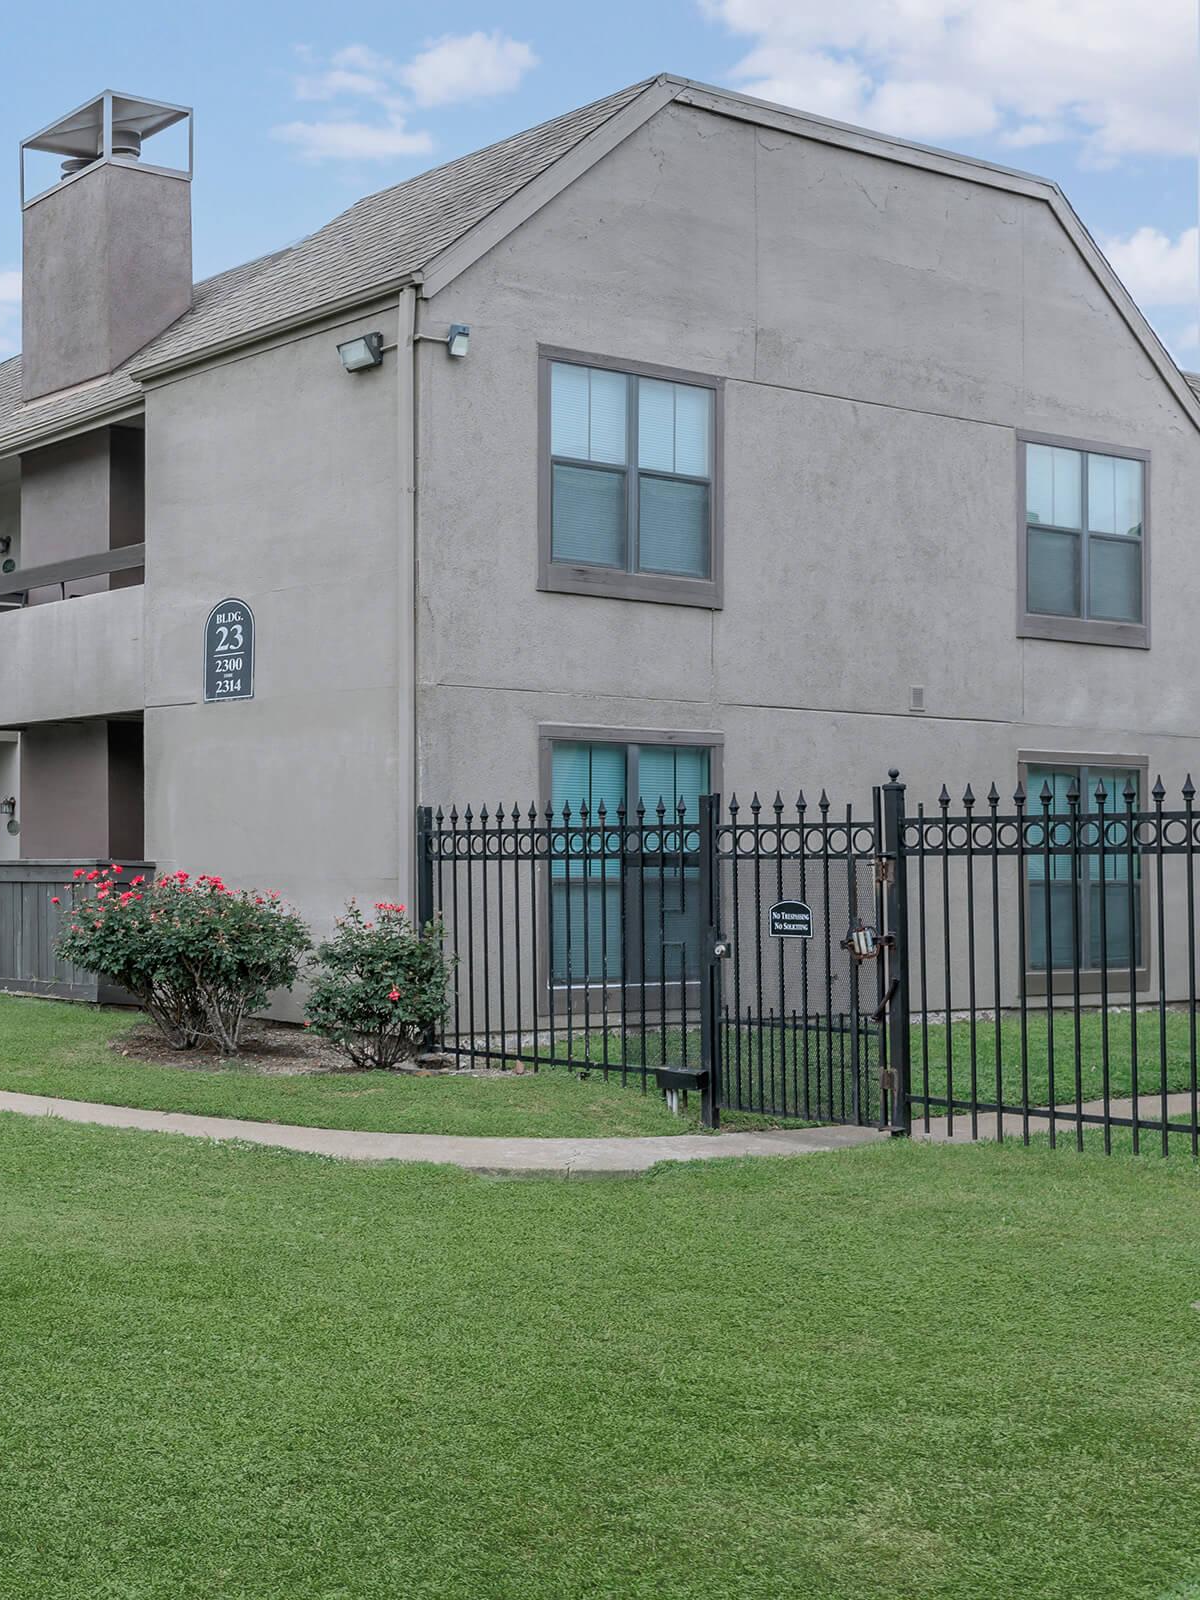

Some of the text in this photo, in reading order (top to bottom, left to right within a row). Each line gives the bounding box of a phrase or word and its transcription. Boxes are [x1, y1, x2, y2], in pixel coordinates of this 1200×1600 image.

[216, 611, 244, 624] BLDG.
[215, 624, 244, 652] 23
[215, 657, 243, 673] 2300
[215, 678, 242, 694] 2314
